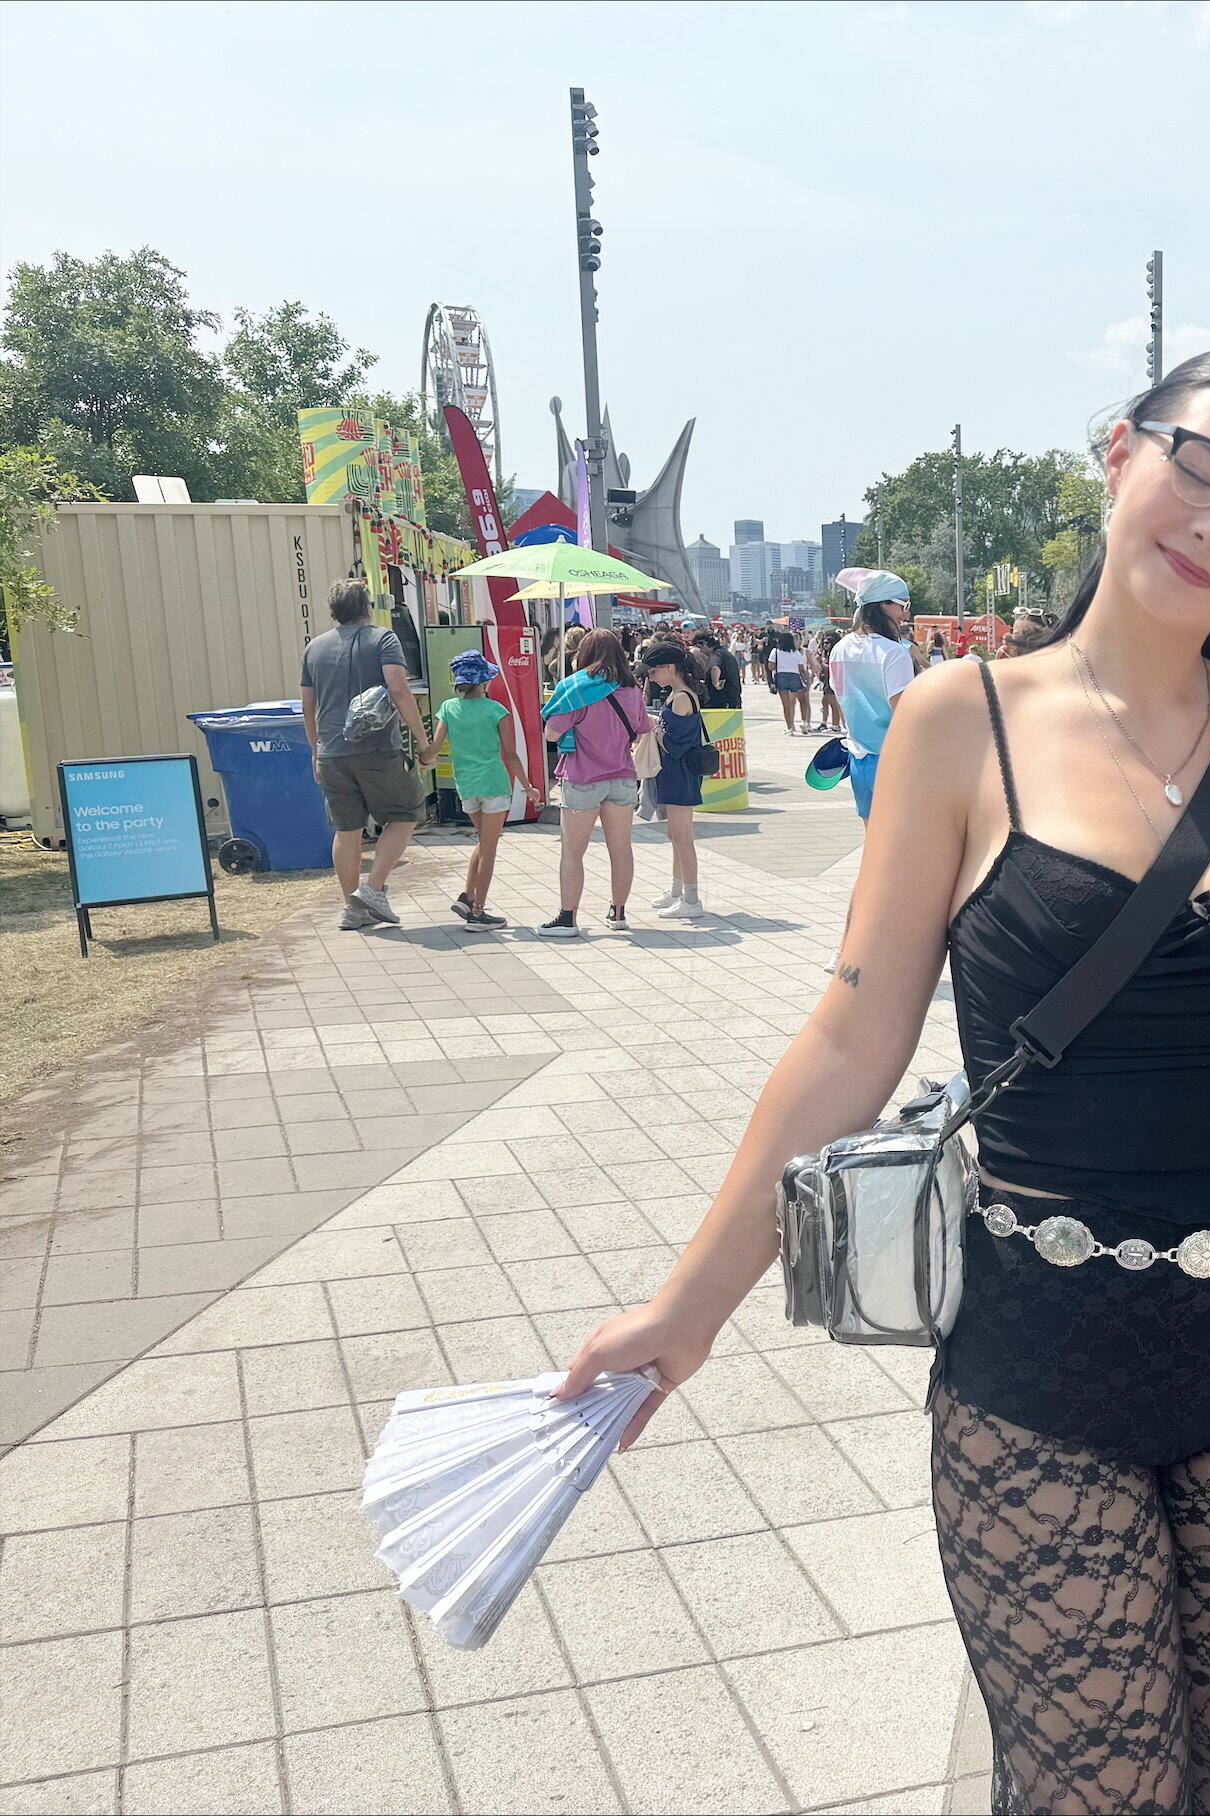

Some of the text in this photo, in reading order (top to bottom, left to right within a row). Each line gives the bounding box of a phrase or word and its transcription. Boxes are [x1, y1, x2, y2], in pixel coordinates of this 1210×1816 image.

[568, 568, 629, 581] OSHEAGA
[249, 740, 291, 753] WM
[68, 770, 126, 782] SAMSUNG
[73, 803, 144, 817] Welcome
[76, 816, 164, 833] to the party
